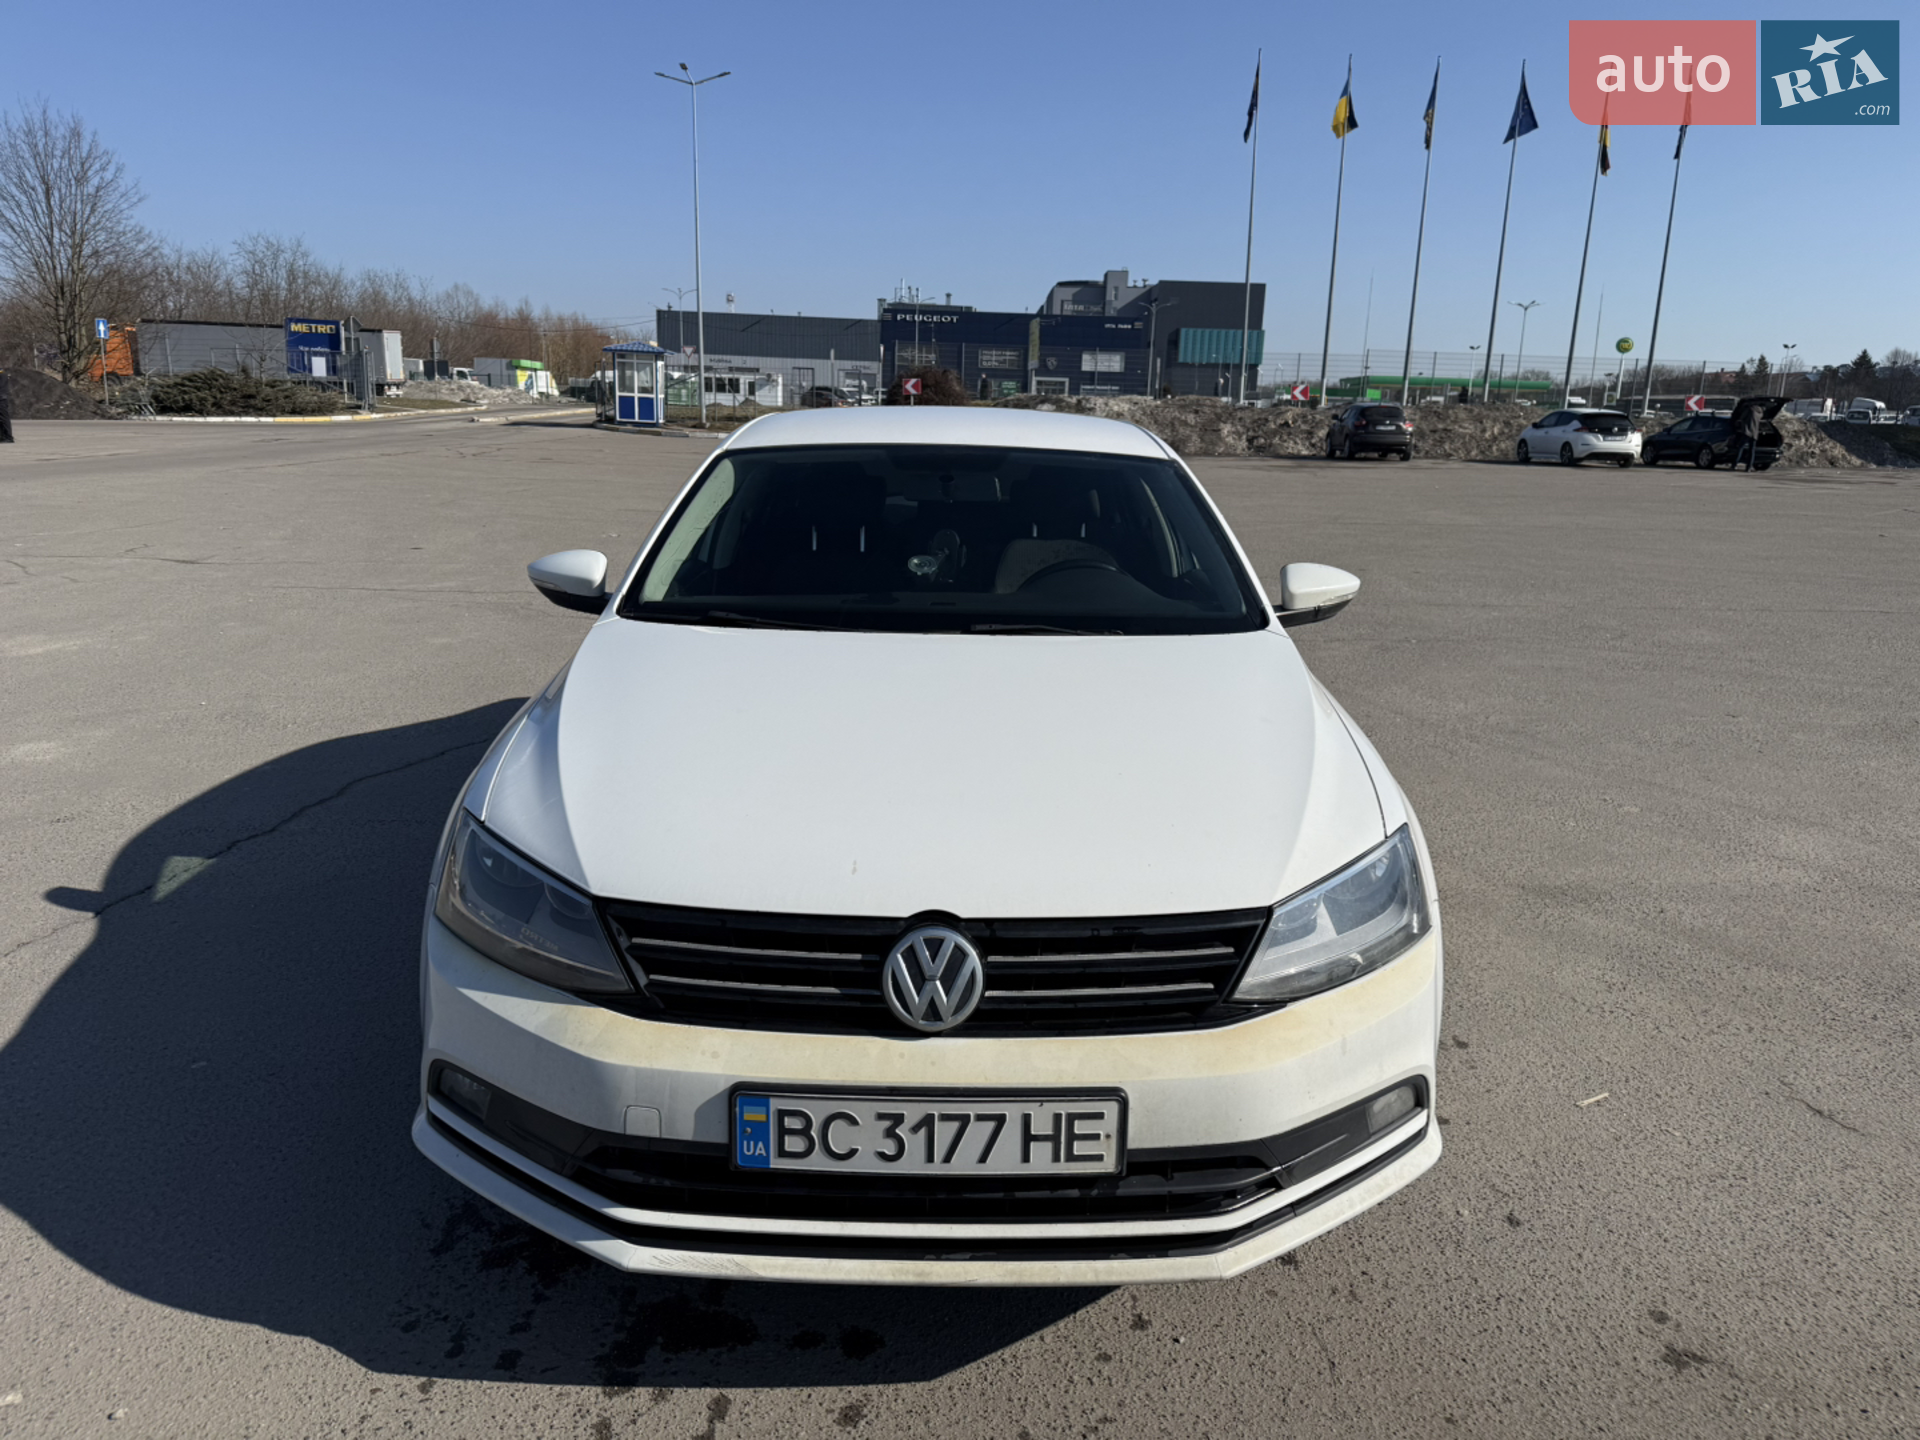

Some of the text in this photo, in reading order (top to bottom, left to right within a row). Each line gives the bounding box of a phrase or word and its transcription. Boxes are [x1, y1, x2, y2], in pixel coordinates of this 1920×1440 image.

[896, 313, 959, 323] PEUGEOT
[290, 322, 335, 333] METRO
[775, 1106, 1107, 1164] BC 3177 HE
[743, 1140, 767, 1157] UA
